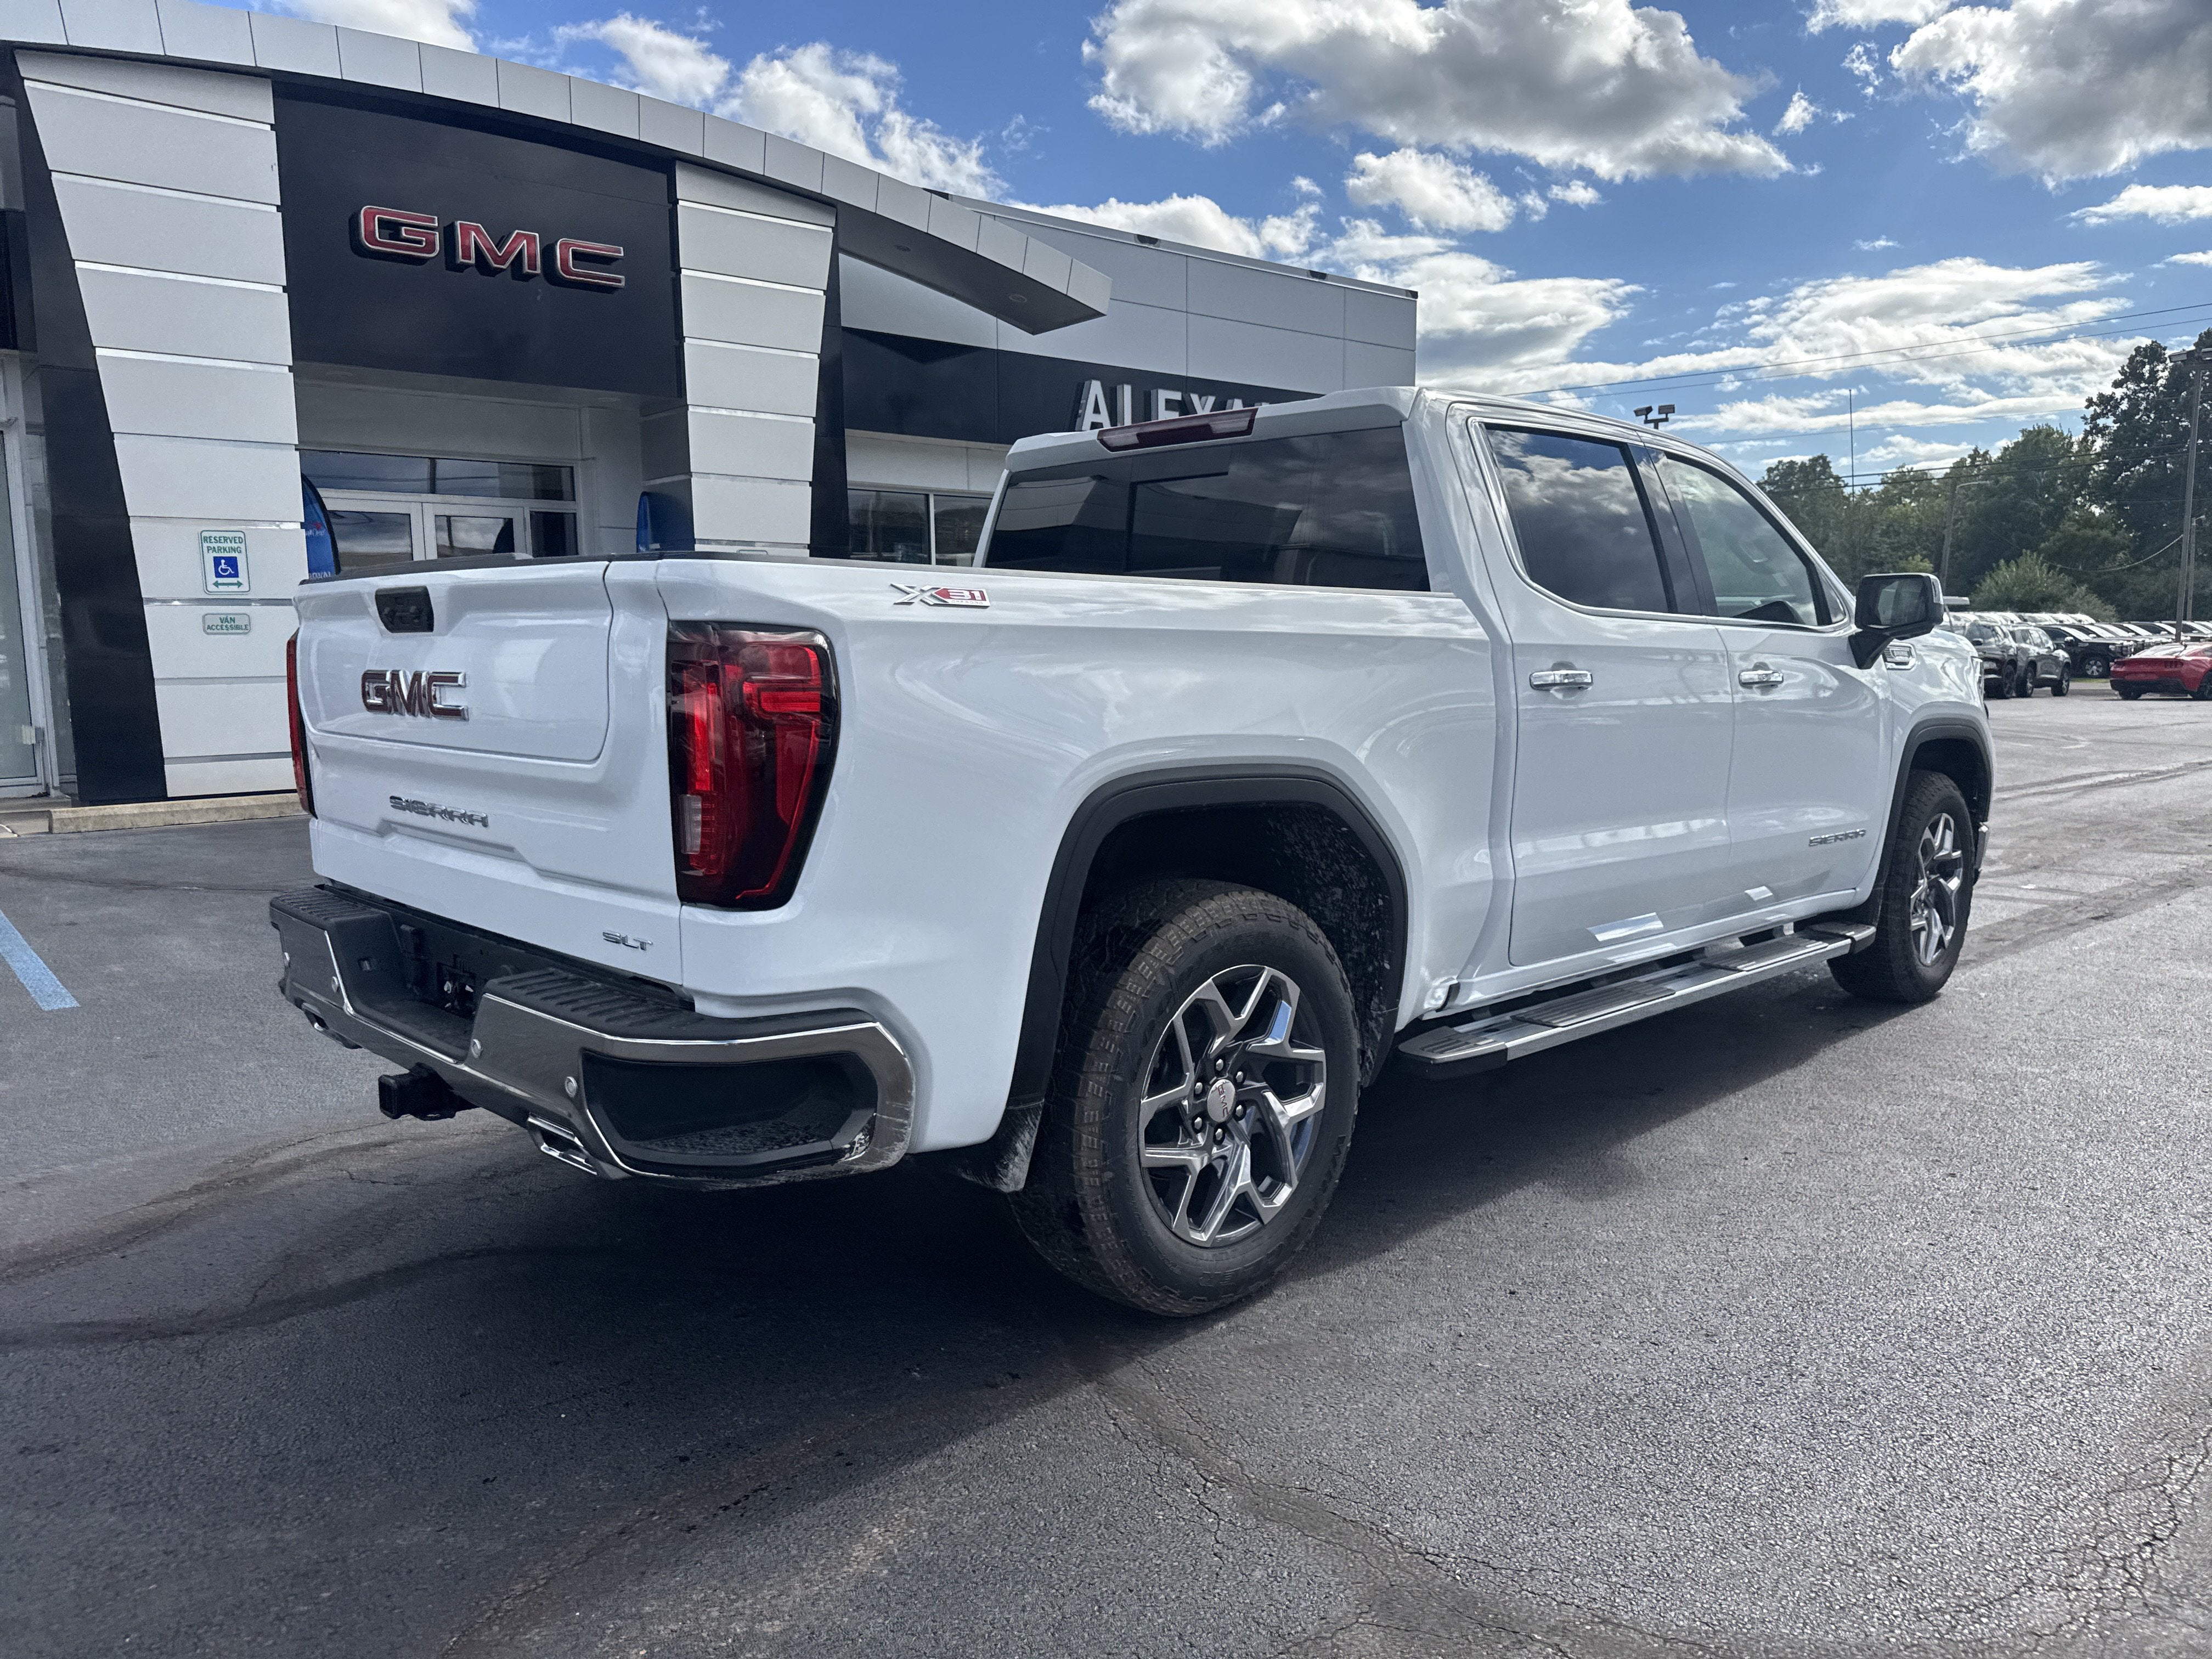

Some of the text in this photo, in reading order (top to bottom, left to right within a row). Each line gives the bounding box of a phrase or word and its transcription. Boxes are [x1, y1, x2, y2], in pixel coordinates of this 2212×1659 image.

[359, 205, 625, 288] GMC
[1076, 379, 1269, 431] ALE
[202, 535, 244, 544] RESERVED
[206, 546, 242, 554] PARKING
[361, 669, 470, 721] GMC
[389, 795, 489, 828] SIERRA
[1809, 828, 1866, 847] SIERRA
[602, 930, 653, 951] SLT
[1217, 1084, 1229, 1117] GMC
